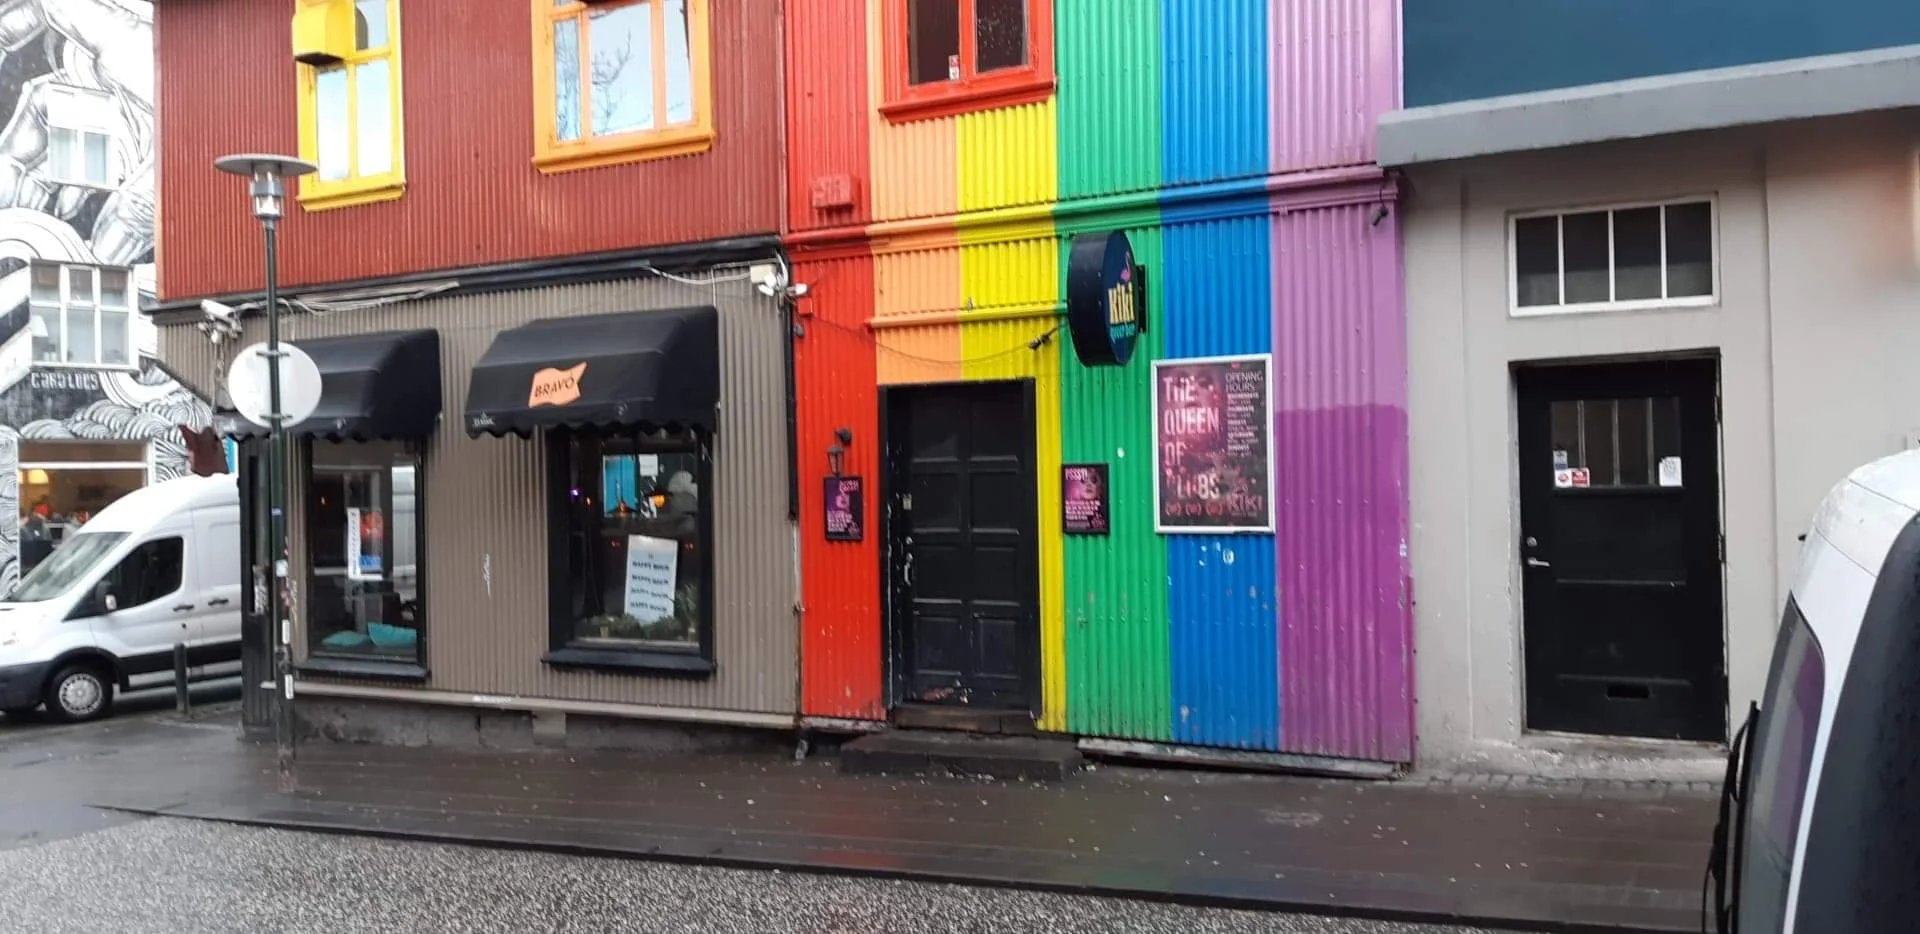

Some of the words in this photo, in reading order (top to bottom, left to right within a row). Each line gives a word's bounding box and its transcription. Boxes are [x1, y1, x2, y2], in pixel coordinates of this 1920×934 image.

[1163, 376, 1196, 403] THE
[1164, 407, 1220, 435] QUEEN
[1165, 440, 1187, 467] OF
